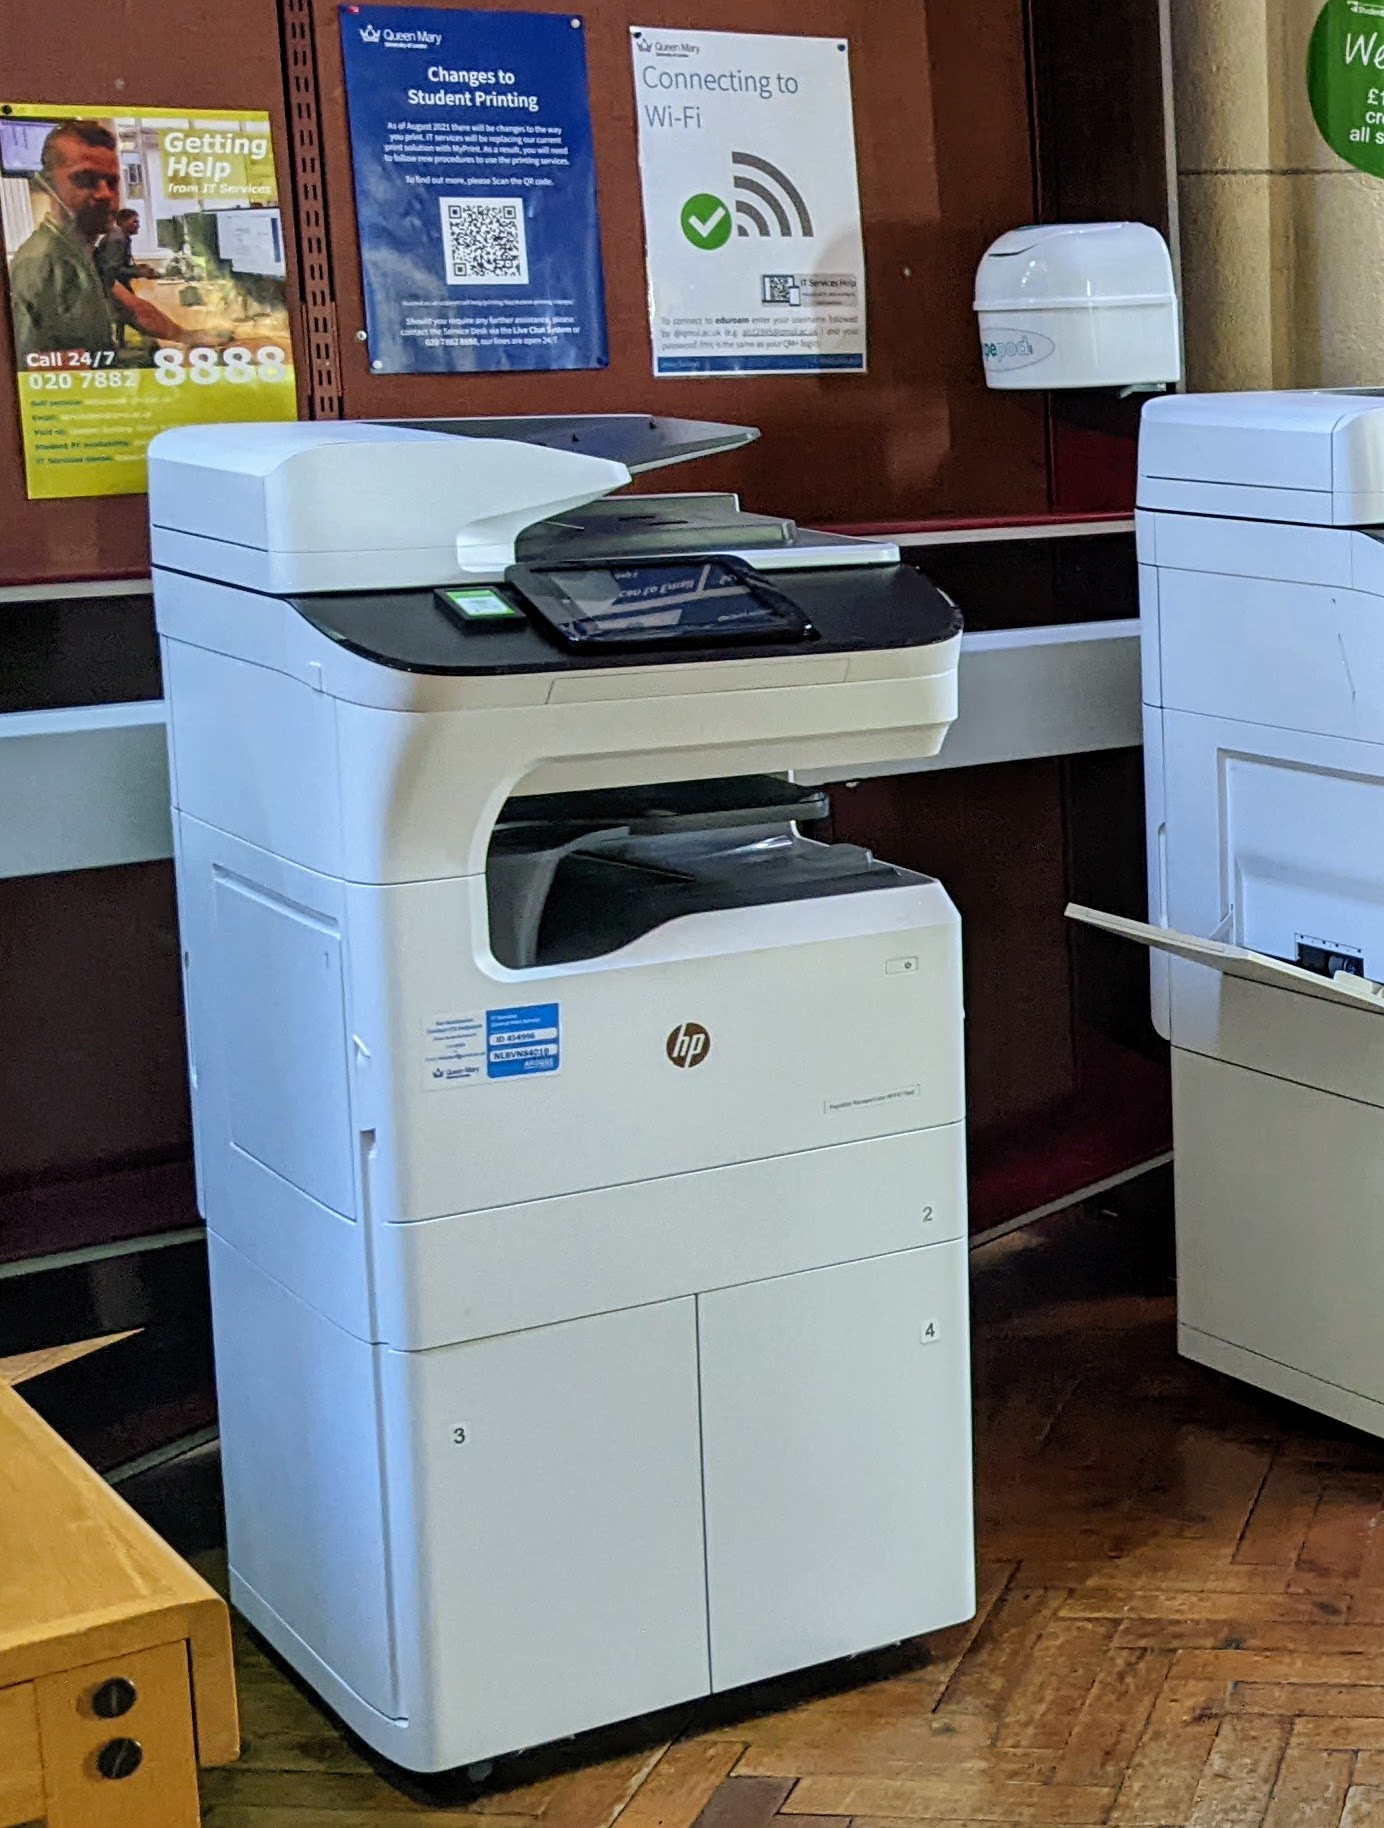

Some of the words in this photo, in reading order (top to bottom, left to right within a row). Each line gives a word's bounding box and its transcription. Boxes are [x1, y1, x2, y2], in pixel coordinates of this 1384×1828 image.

[383, 29, 415, 42] Queen
[416, 31, 442, 46] Mary
[655, 42, 680, 52] Queen
[681, 43, 700, 54] Mary
[427, 66, 496, 88] Changes
[498, 70, 515, 85] to
[642, 65, 773, 100] Connecting
[776, 73, 799, 94] to
[407, 89, 473, 106] Student
[474, 91, 539, 112] Printing
[644, 104, 702, 129] Wi-Fi
[496, 124, 525, 135] changes
[1349, 127, 1371, 142] all
[164, 132, 268, 160] Getting
[167, 157, 232, 182] Help
[168, 183, 198, 193] from
[202, 184, 217, 194] IT
[220, 183, 272, 194] Services
[809, 279, 839, 287] Services
[715, 317, 750, 325] eduroam
[26, 352, 62, 367] Call
[69, 351, 115, 367] 24/7
[28, 374, 72, 390] 020
[80, 372, 137, 389] 7882
[153, 347, 286, 386] 8888
[670, 1022, 707, 1068] hp
[922, 1206, 933, 1222] 2
[925, 1323, 936, 1338] 4
[454, 1427, 466, 1444] 3
